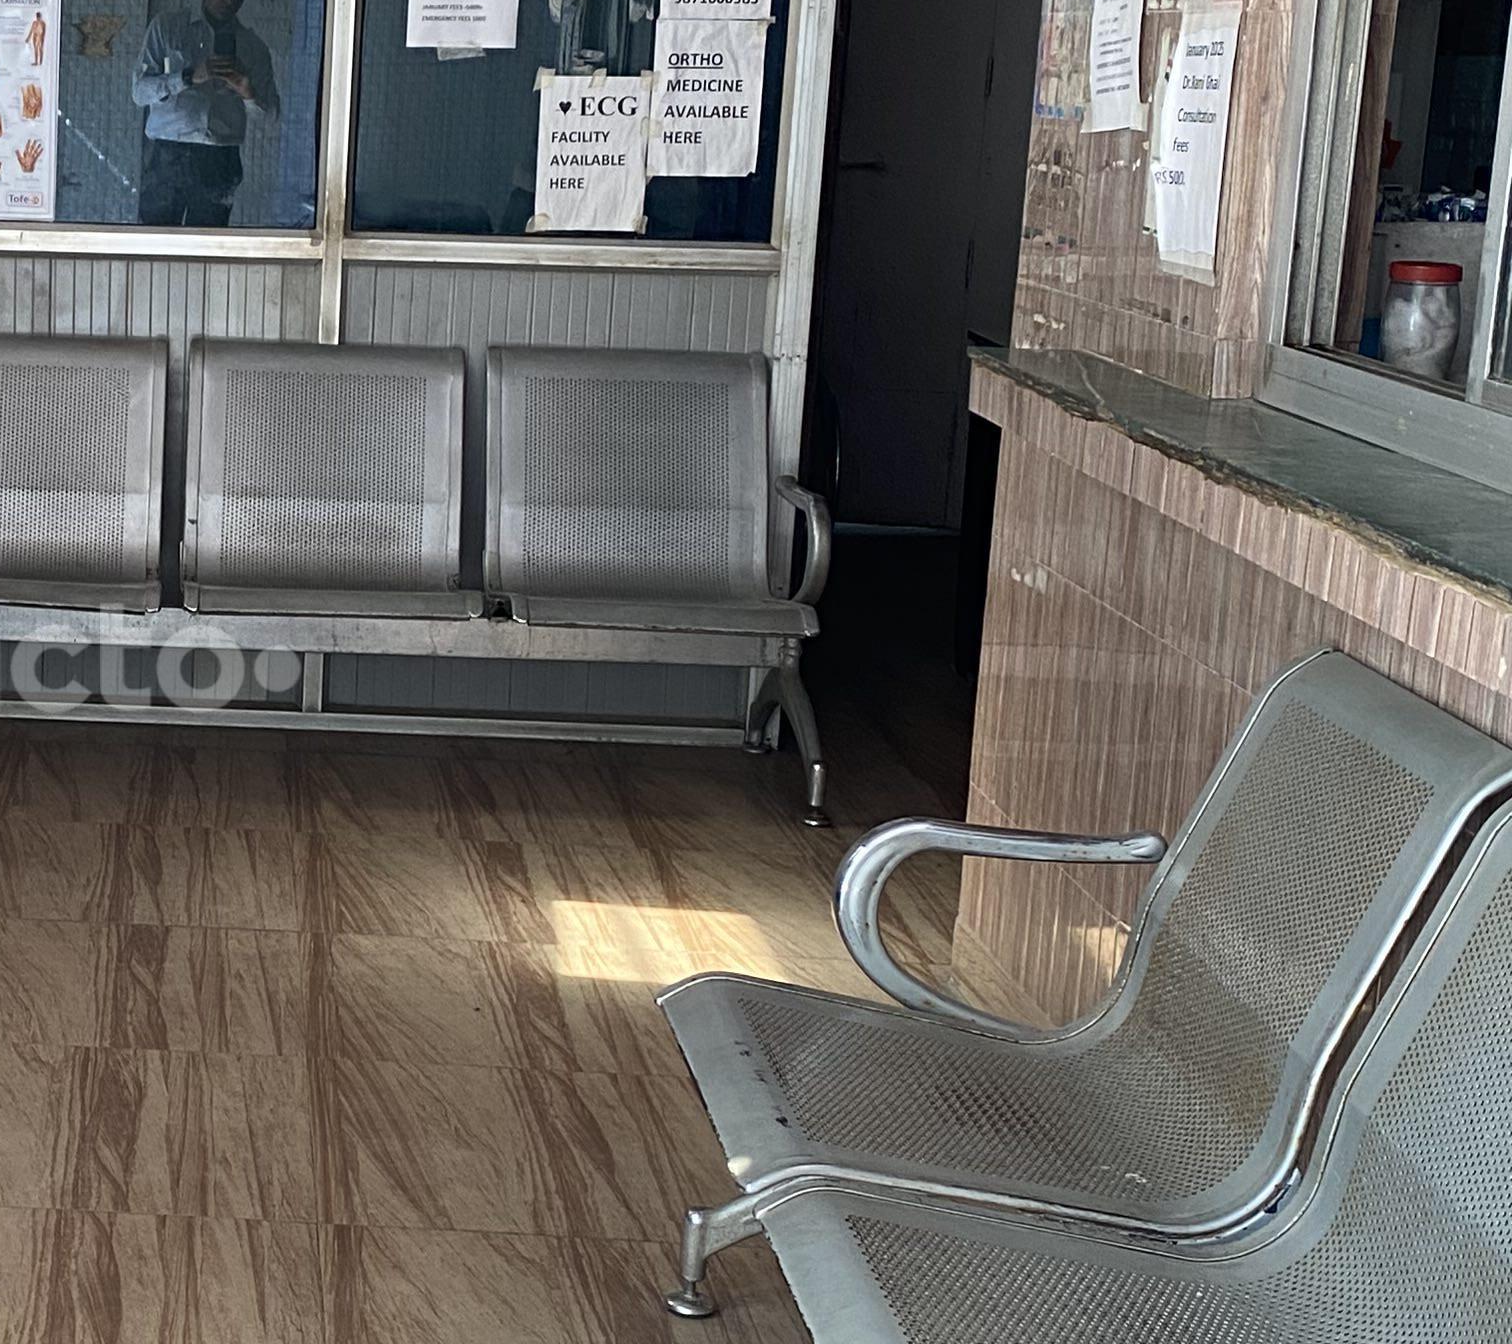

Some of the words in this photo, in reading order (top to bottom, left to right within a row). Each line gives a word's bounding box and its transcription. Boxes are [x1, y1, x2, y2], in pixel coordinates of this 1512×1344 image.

[667, 53, 724, 68] ORTHO
[666, 79, 743, 93] MEDICINE
[579, 95, 638, 118] ECG
[664, 105, 749, 119] AVAILABLE
[1177, 107, 1216, 123] Consultation
[551, 131, 610, 144] FACILITY
[662, 131, 702, 145] HERE
[550, 153, 626, 167] AVAILABLE
[549, 177, 585, 190] HERE
